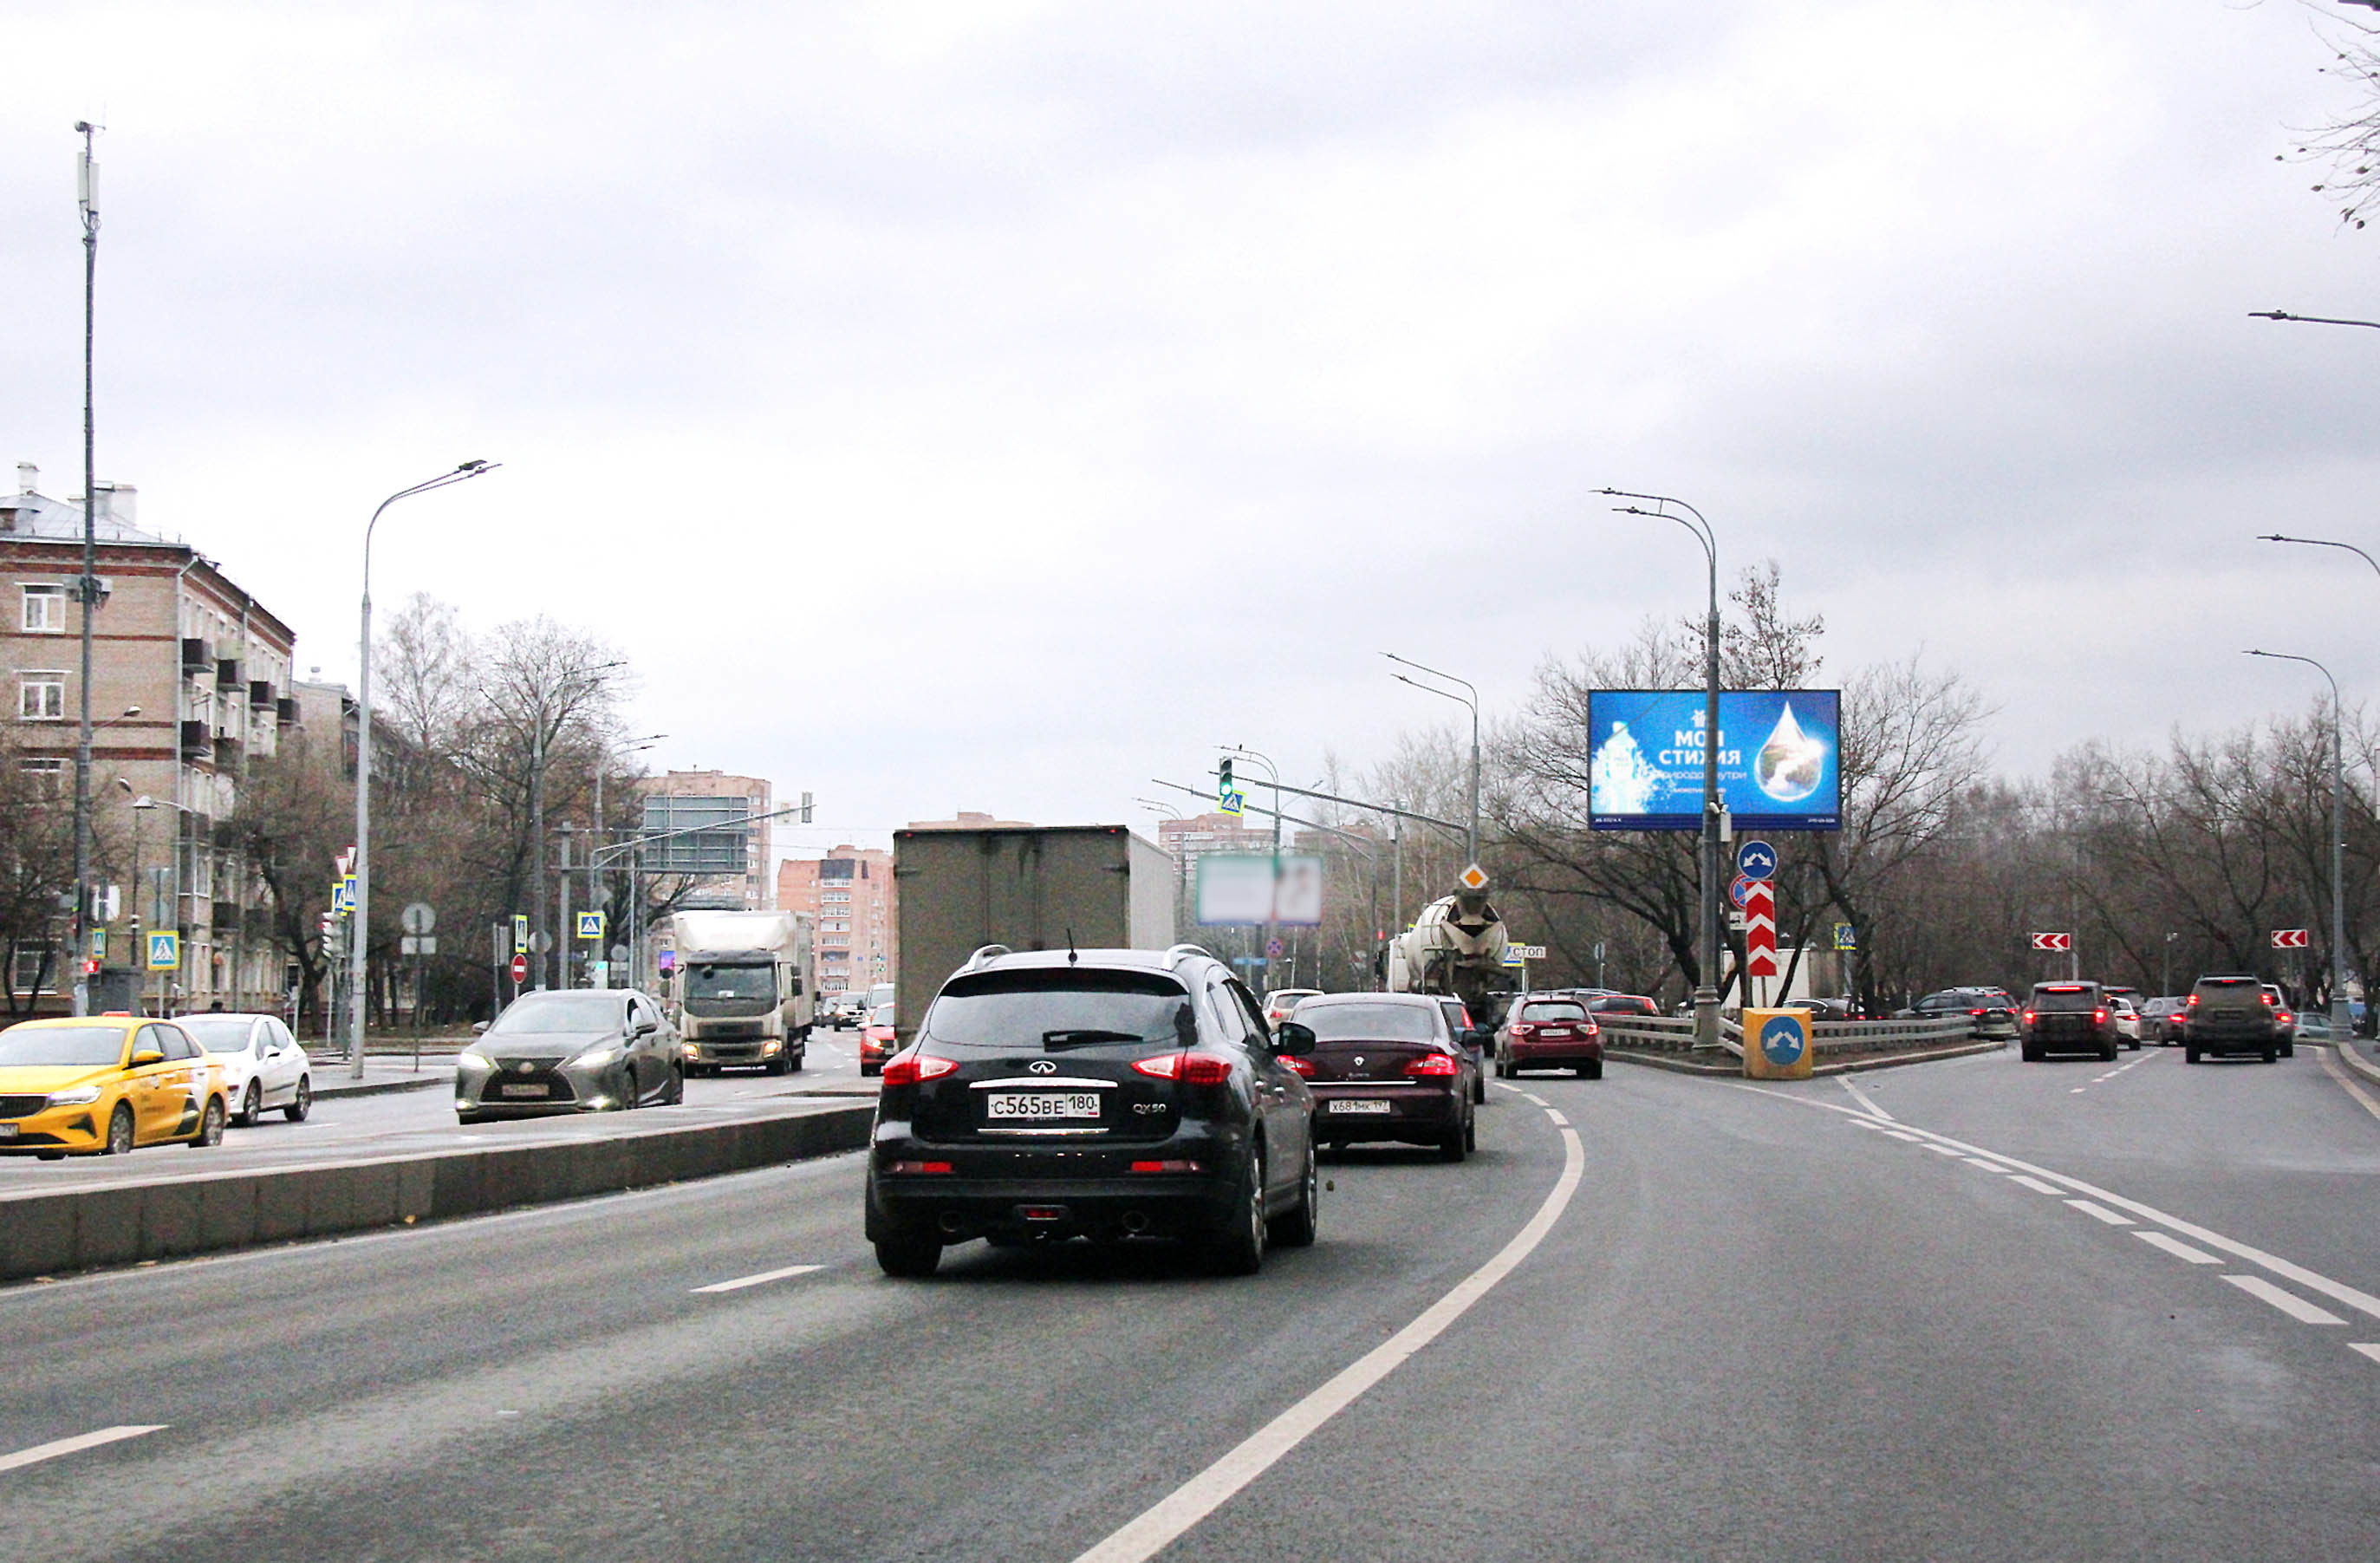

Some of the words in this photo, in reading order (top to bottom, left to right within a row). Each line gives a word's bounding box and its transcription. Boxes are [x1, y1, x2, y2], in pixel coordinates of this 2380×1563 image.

[1512, 947, 1544, 957] СТОП
[1069, 1095, 1095, 1110] 180
[1133, 1104, 1167, 1115] QX50
